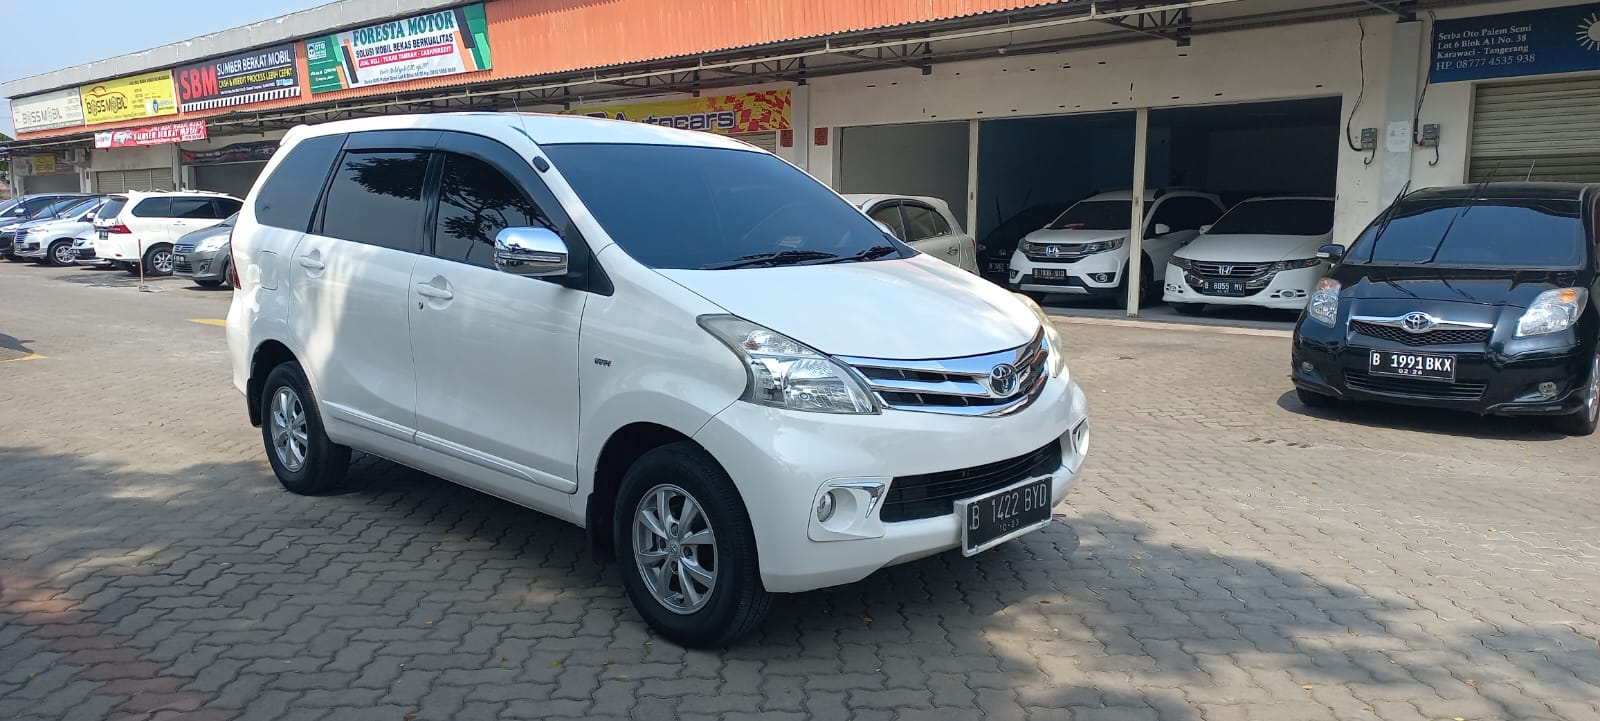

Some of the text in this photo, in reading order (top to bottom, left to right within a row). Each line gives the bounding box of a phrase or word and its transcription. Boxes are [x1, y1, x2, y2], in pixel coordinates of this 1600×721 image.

[353, 11, 454, 47] FORESTA MOTOR
[1463, 30, 1479, 38] Oto
[1481, 28, 1508, 36] Palem
[1509, 24, 1532, 33] Semi
[356, 33, 453, 58] SOLUSI MOBIL BEKAS BERKUALITAS
[1461, 39, 1480, 47] Blok
[1498, 35, 1513, 44] No.
[1515, 34, 1527, 42] 38
[217, 50, 291, 75] SUMBER BERKAT MOBIL
[1437, 49, 1475, 59] Karawaci
[1484, 45, 1529, 55] Tangerang
[1456, 58, 1486, 68] 08777
[1488, 55, 1513, 65] 4535
[1516, 54, 1536, 63] 938
[180, 65, 218, 99] SBM
[1372, 352, 1452, 372] B 1991 BKX
[971, 483, 1047, 530] B 1422 BYD
